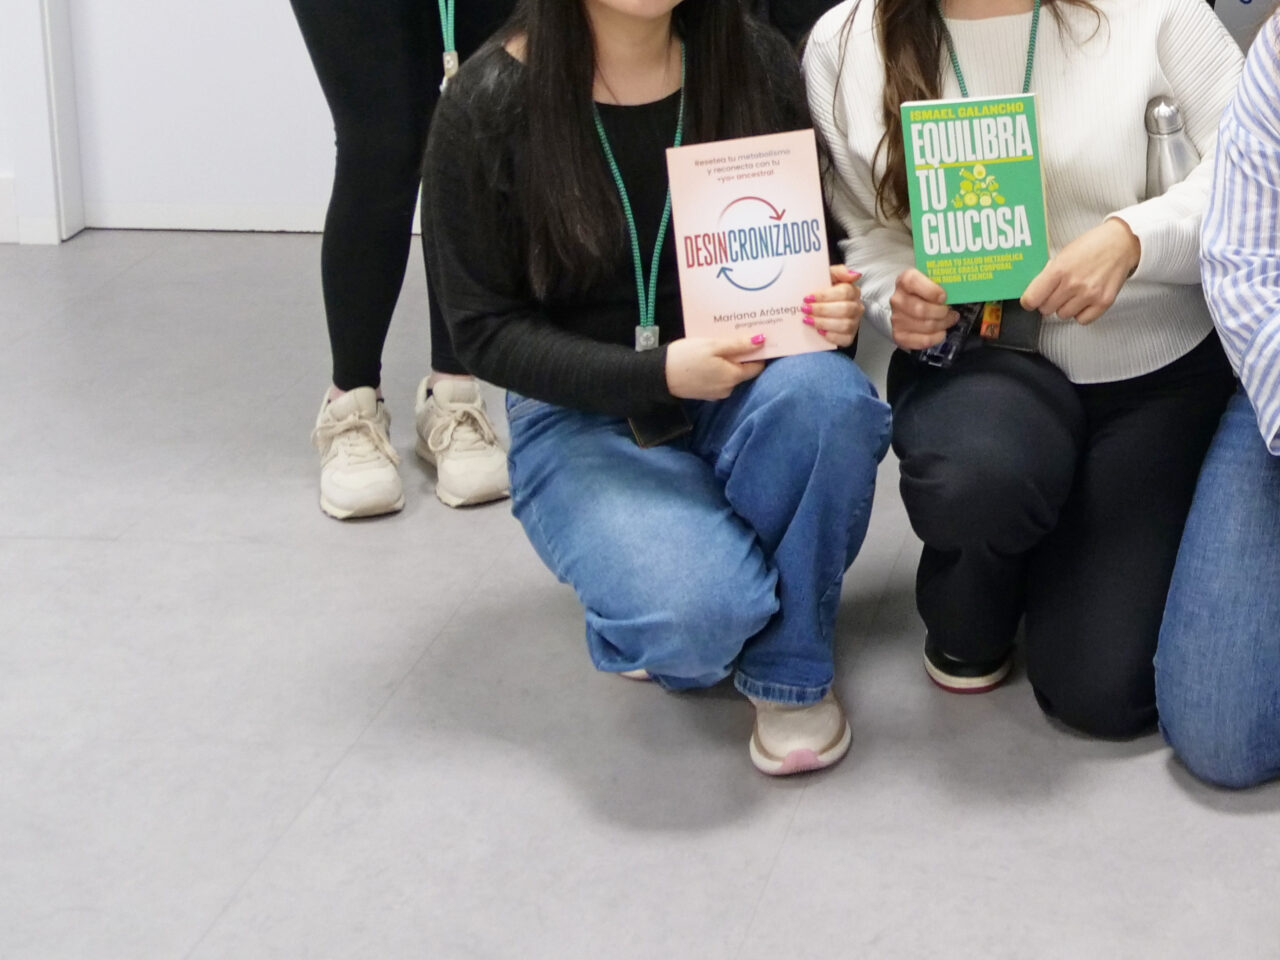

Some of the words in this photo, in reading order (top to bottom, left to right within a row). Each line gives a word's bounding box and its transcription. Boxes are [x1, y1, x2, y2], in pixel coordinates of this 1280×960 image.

[910, 108, 955, 121] ISMAEL
[958, 101, 1024, 118] GALANCHO
[738, 149, 790, 160] metabolismo
[911, 114, 1033, 168] EQUILIBRA
[915, 168, 947, 211] TU
[684, 218, 821, 268] DESINCRONIZADOS
[921, 205, 1032, 255] GLUCOSA
[713, 311, 757, 323] Mariana
[760, 305, 802, 317] Aróstegu
